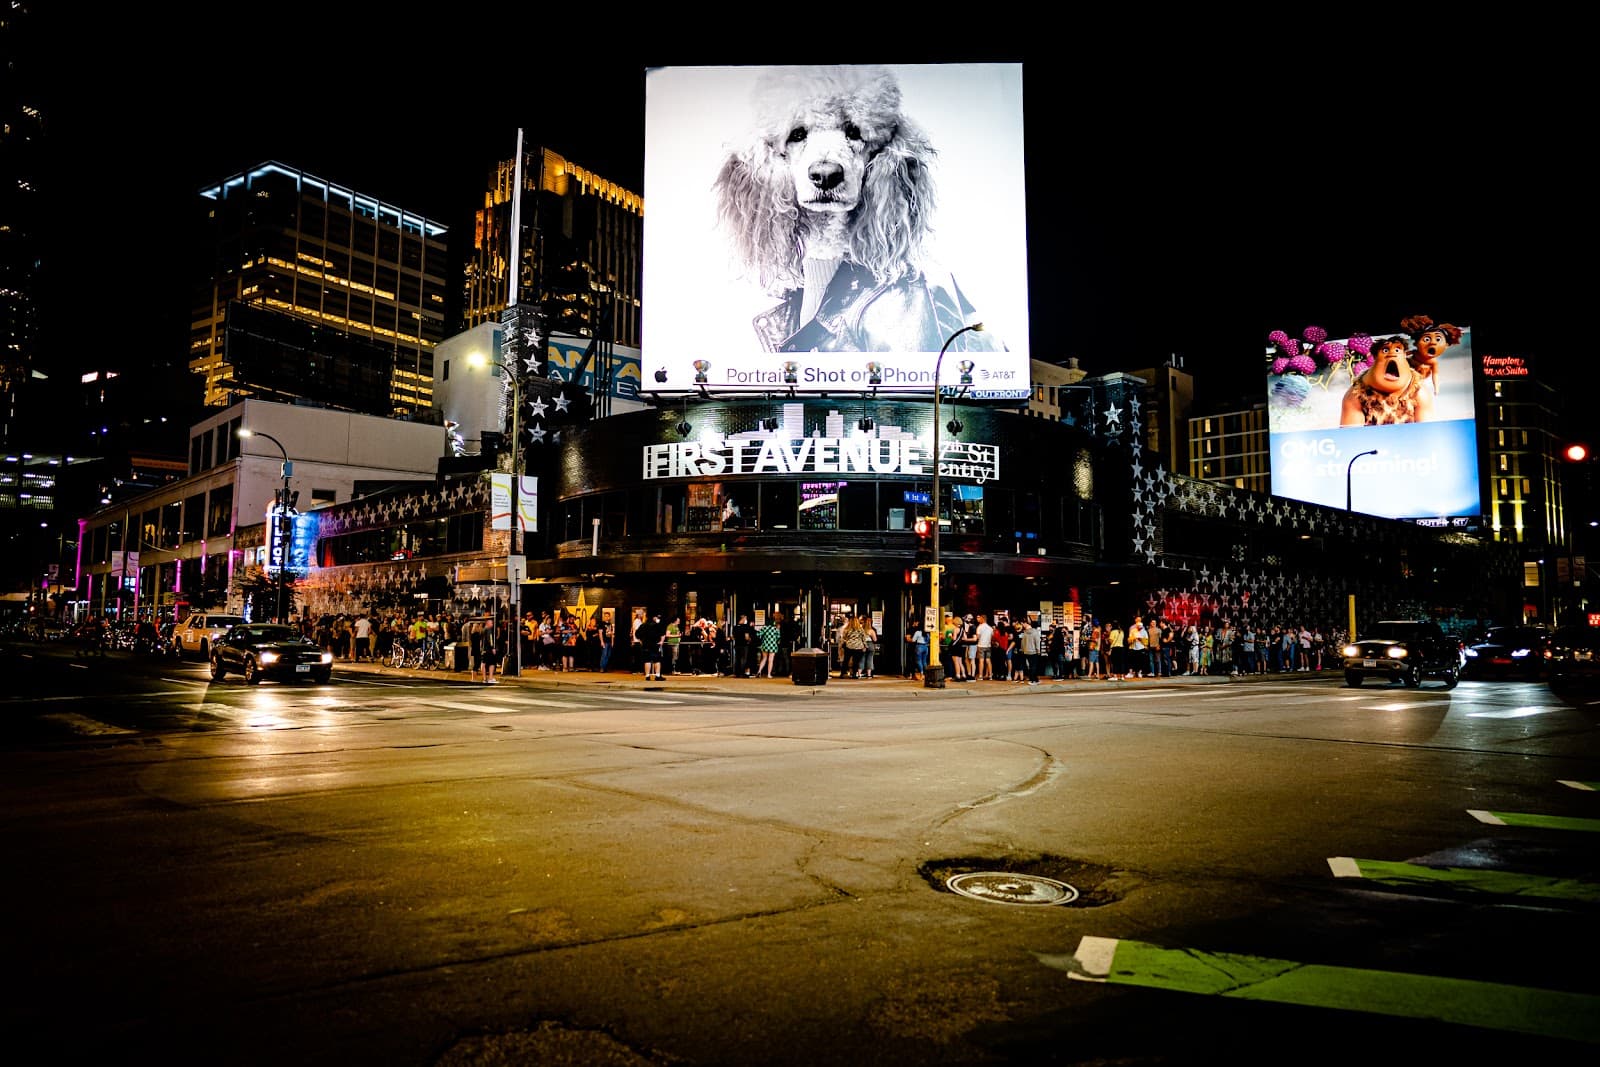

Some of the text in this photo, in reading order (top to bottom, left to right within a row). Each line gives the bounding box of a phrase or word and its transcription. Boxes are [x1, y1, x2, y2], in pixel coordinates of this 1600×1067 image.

[1483, 355, 1524, 366] Hampton
[804, 367, 846, 382] Shot
[992, 370, 1015, 379] AT&T
[1505, 366, 1528, 375] Suites
[939, 386, 956, 395] 217
[975, 390, 1024, 398] OUTFRONT
[652, 438, 751, 478] FIRST
[753, 438, 923, 475] AVENUE
[968, 443, 991, 463] St
[938, 462, 992, 484] entry
[574, 608, 587, 633] 50
